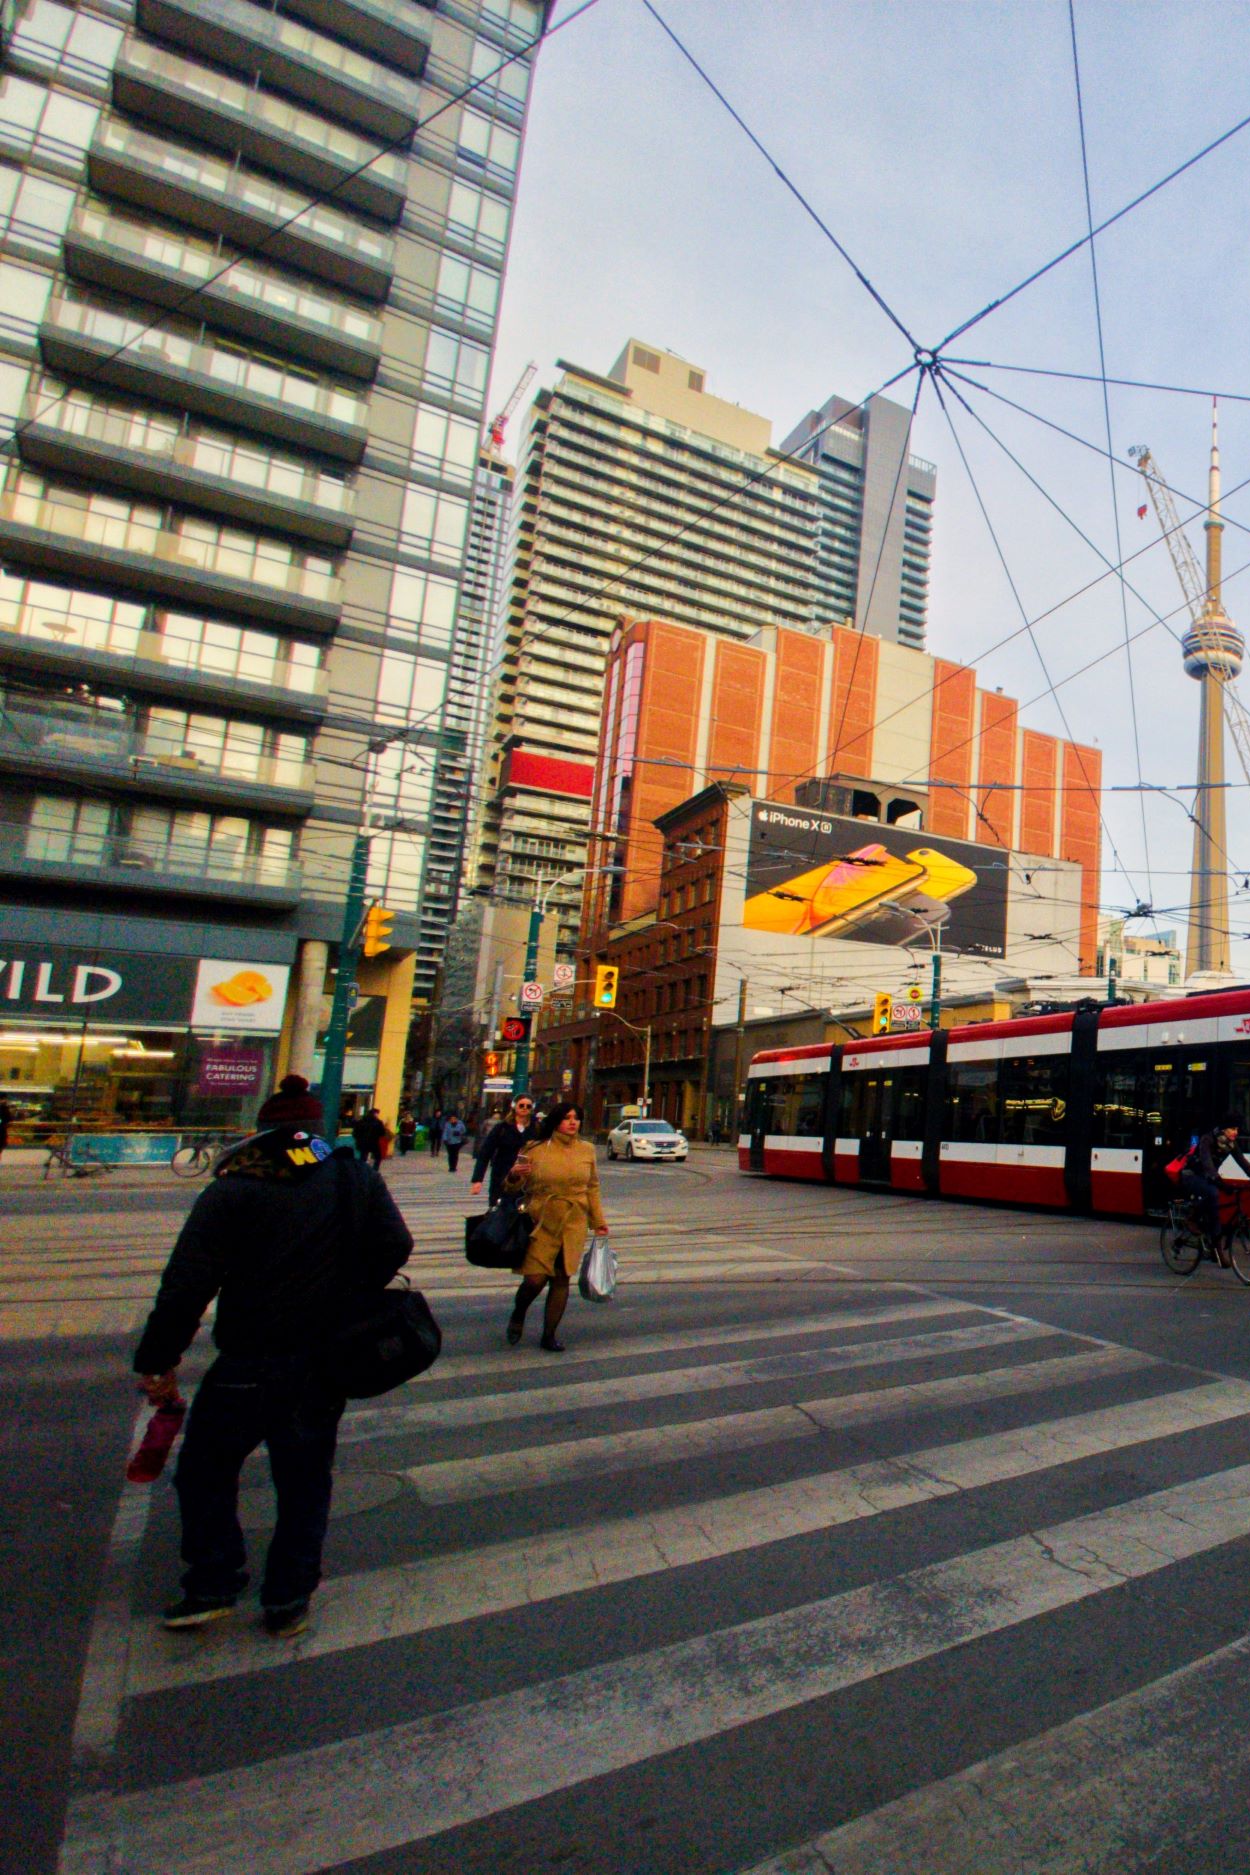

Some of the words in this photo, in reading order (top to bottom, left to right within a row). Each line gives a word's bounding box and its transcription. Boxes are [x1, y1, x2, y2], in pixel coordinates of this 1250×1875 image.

[769, 811, 809, 829] iPhone
[0, 959, 122, 1003] ILD
[206, 1064, 257, 1073] FABULOUS
[206, 1072, 256, 1081] CATERING
